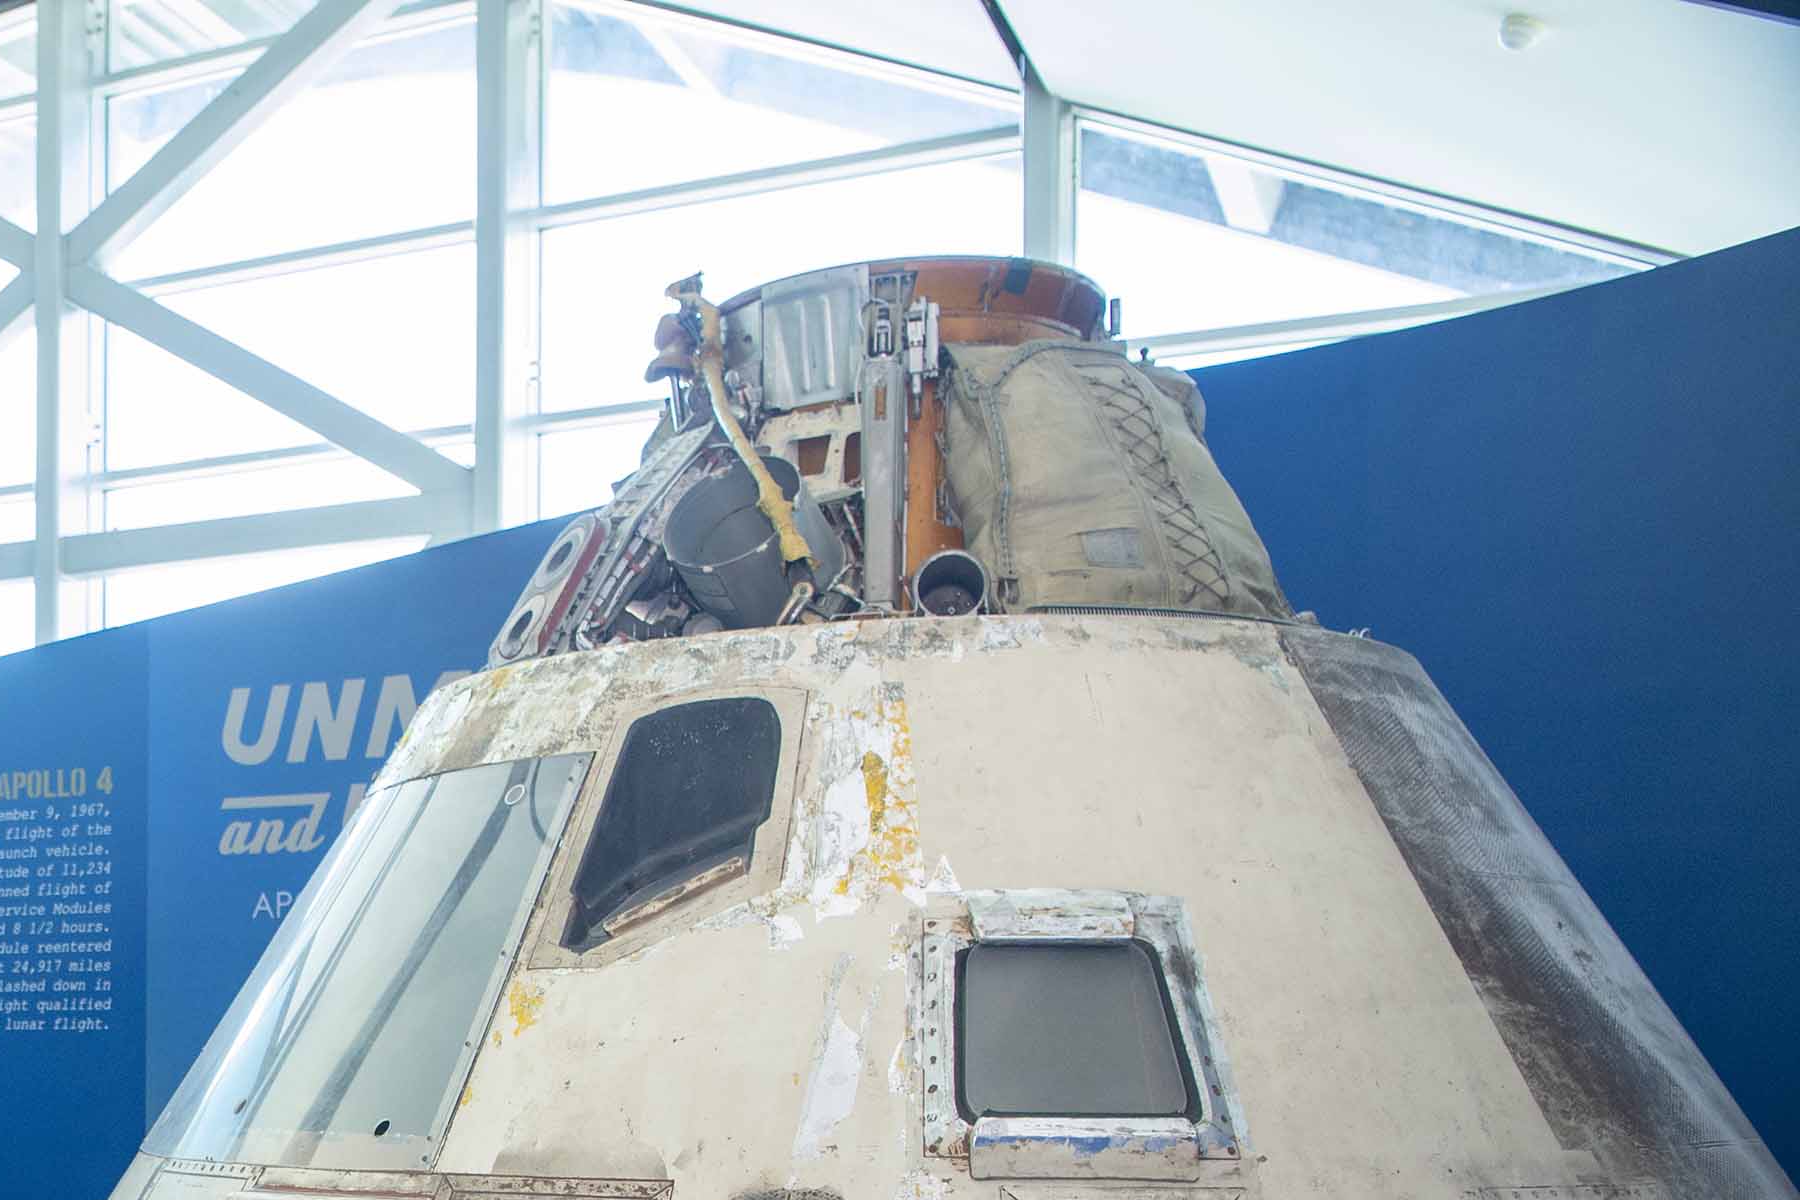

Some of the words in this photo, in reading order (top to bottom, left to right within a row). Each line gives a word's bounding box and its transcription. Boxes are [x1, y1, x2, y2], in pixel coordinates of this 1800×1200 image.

[96, 766, 113, 794] 4
[47, 807, 60, 820] 9,
[71, 803, 110, 818] 1967,
[218, 792, 331, 855] and
[5, 827, 52, 841] flight
[62, 826, 80, 837] of
[87, 824, 112, 836] the
[46, 844, 110, 857] vehicle.
[37, 865, 53, 876] of
[63, 862, 111, 877] 11,234
[37, 882, 86, 897] flight
[95, 881, 111, 894] of
[53, 902, 111, 914] Modules
[13, 924, 21, 934] 8
[29, 922, 54, 934] 1/2
[62, 921, 110, 933] hours.
[38, 940, 112, 953] reentered
[12, 960, 61, 974] 24,917
[68, 960, 111, 972] miles
[53, 979, 86, 991] down
[96, 978, 111, 991] in
[37, 998, 112, 1013] qualified
[5, 1018, 45, 1030] lunar
[53, 1017, 109, 1033] flight.
